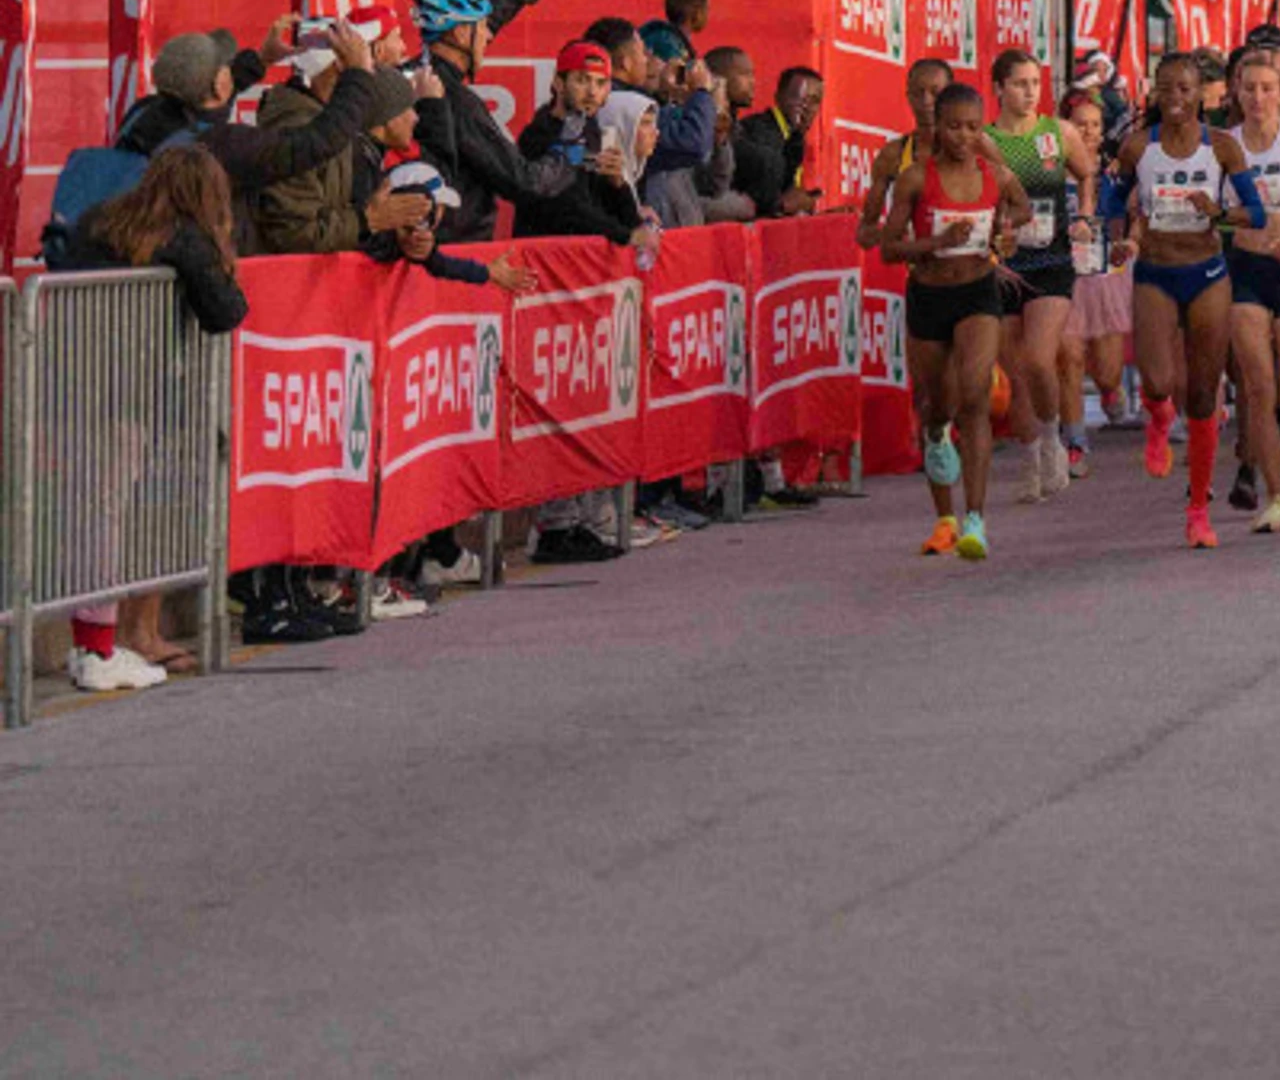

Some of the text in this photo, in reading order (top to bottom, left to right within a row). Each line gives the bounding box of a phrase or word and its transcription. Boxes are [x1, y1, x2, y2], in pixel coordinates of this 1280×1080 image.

[841, 142, 879, 198] SPA
[533, 318, 611, 405] SPAR
[668, 318, 725, 379] SPAR
[774, 294, 841, 366] SPAR
[863, 311, 888, 365] AR
[264, 370, 343, 449] SPAR
[404, 340, 476, 428] SPAR
